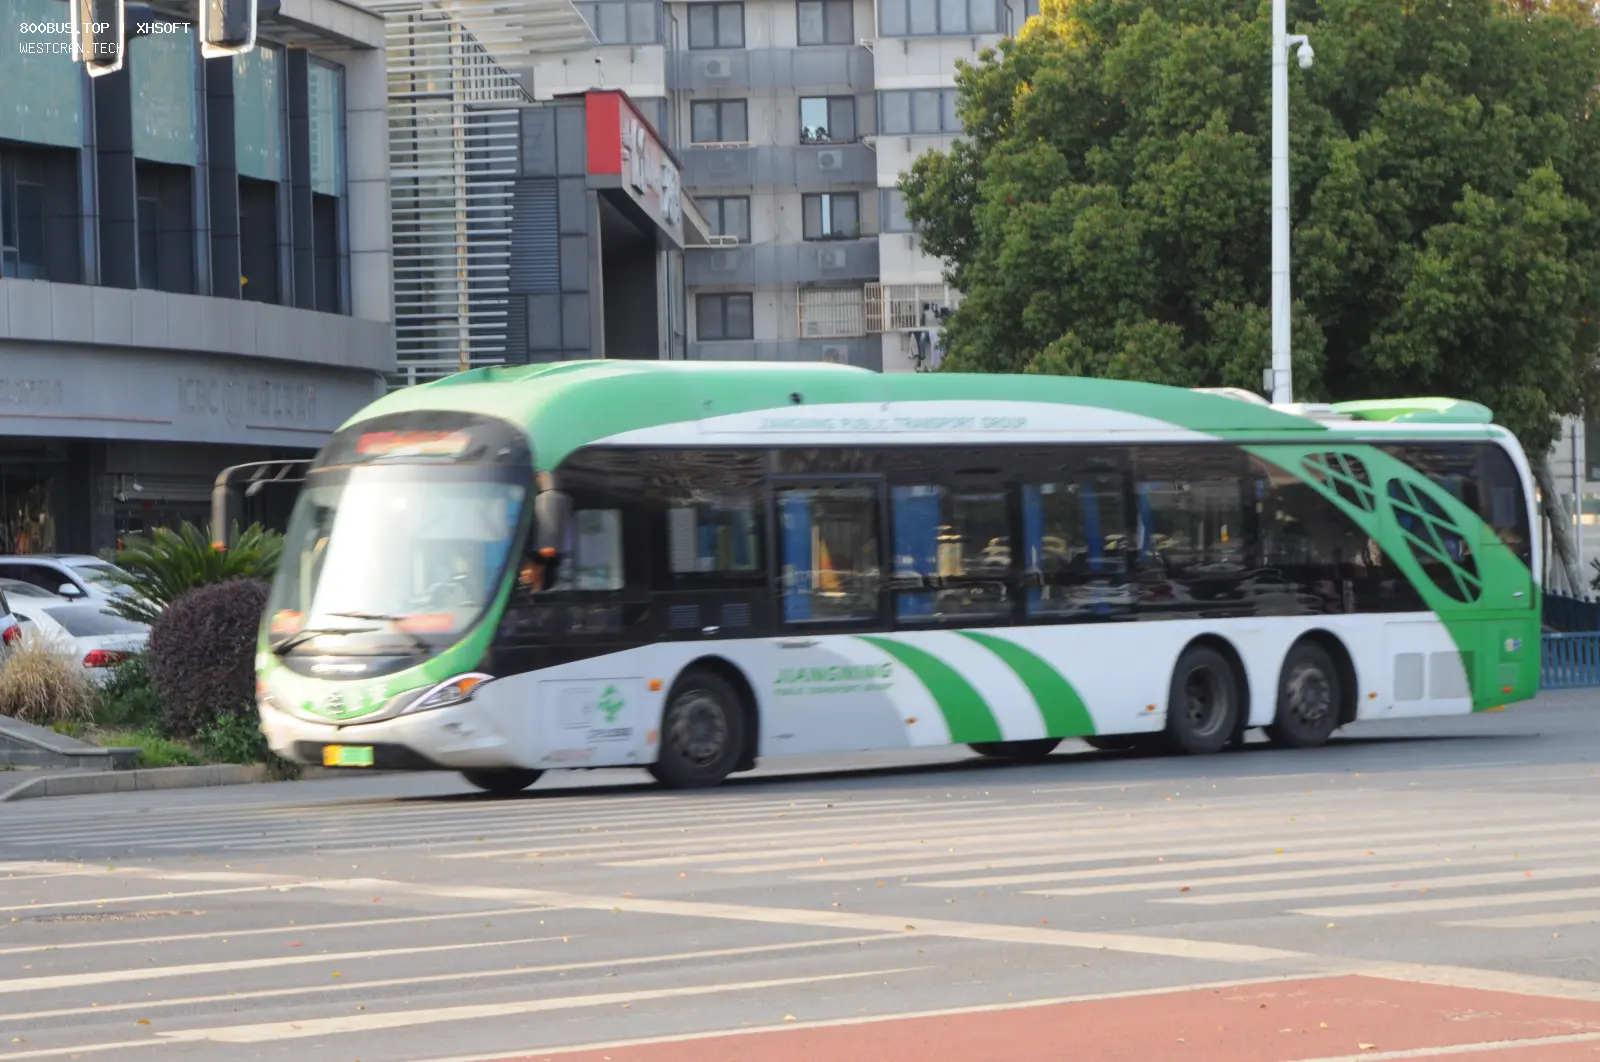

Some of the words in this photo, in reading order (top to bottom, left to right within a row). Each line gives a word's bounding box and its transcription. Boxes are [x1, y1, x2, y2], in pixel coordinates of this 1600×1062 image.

[178, 377, 219, 416] ICBC
[981, 416, 1028, 429] GROUP
[774, 662, 893, 684] JIANGNING
